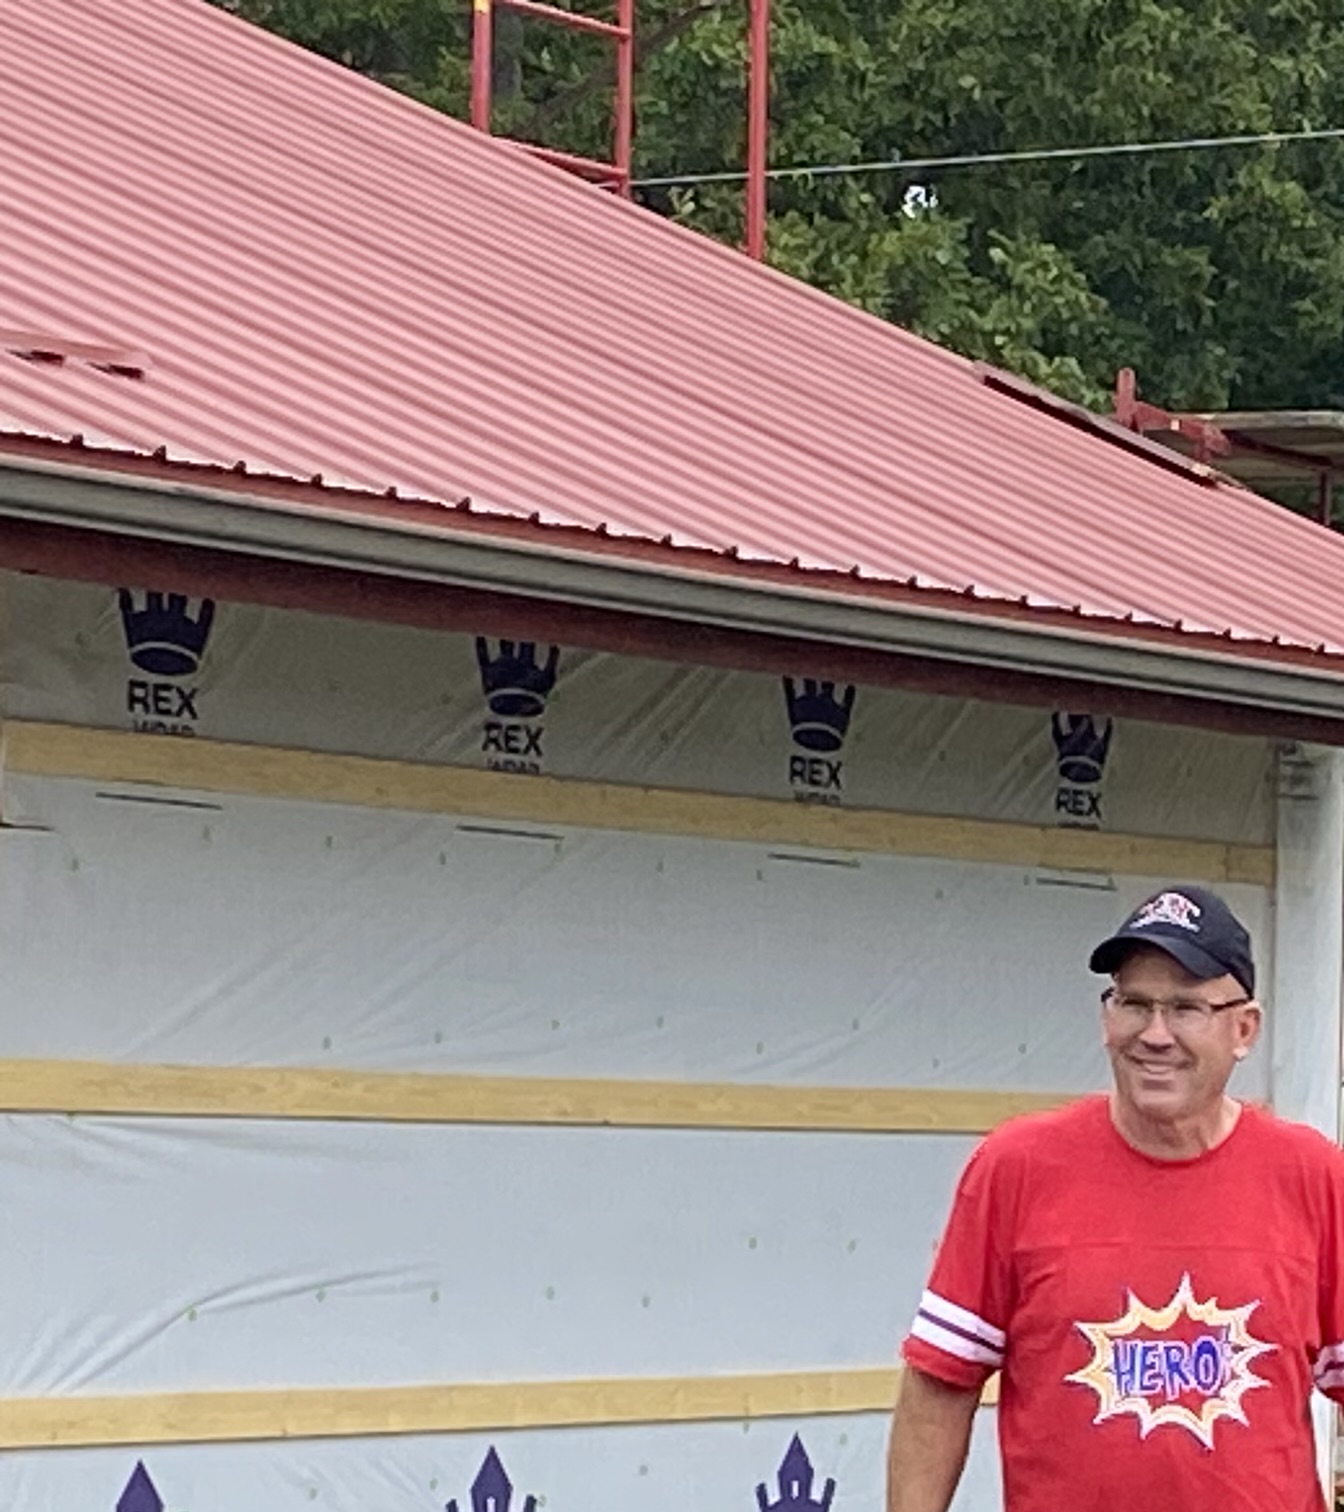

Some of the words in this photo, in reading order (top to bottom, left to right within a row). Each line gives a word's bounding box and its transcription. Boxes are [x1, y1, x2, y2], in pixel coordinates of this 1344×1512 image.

[128, 679, 199, 720] REX
[481, 722, 544, 757] REX
[790, 755, 843, 790] REX
[1055, 787, 1102, 819] REX
[1112, 1336, 1222, 1400] HERO
